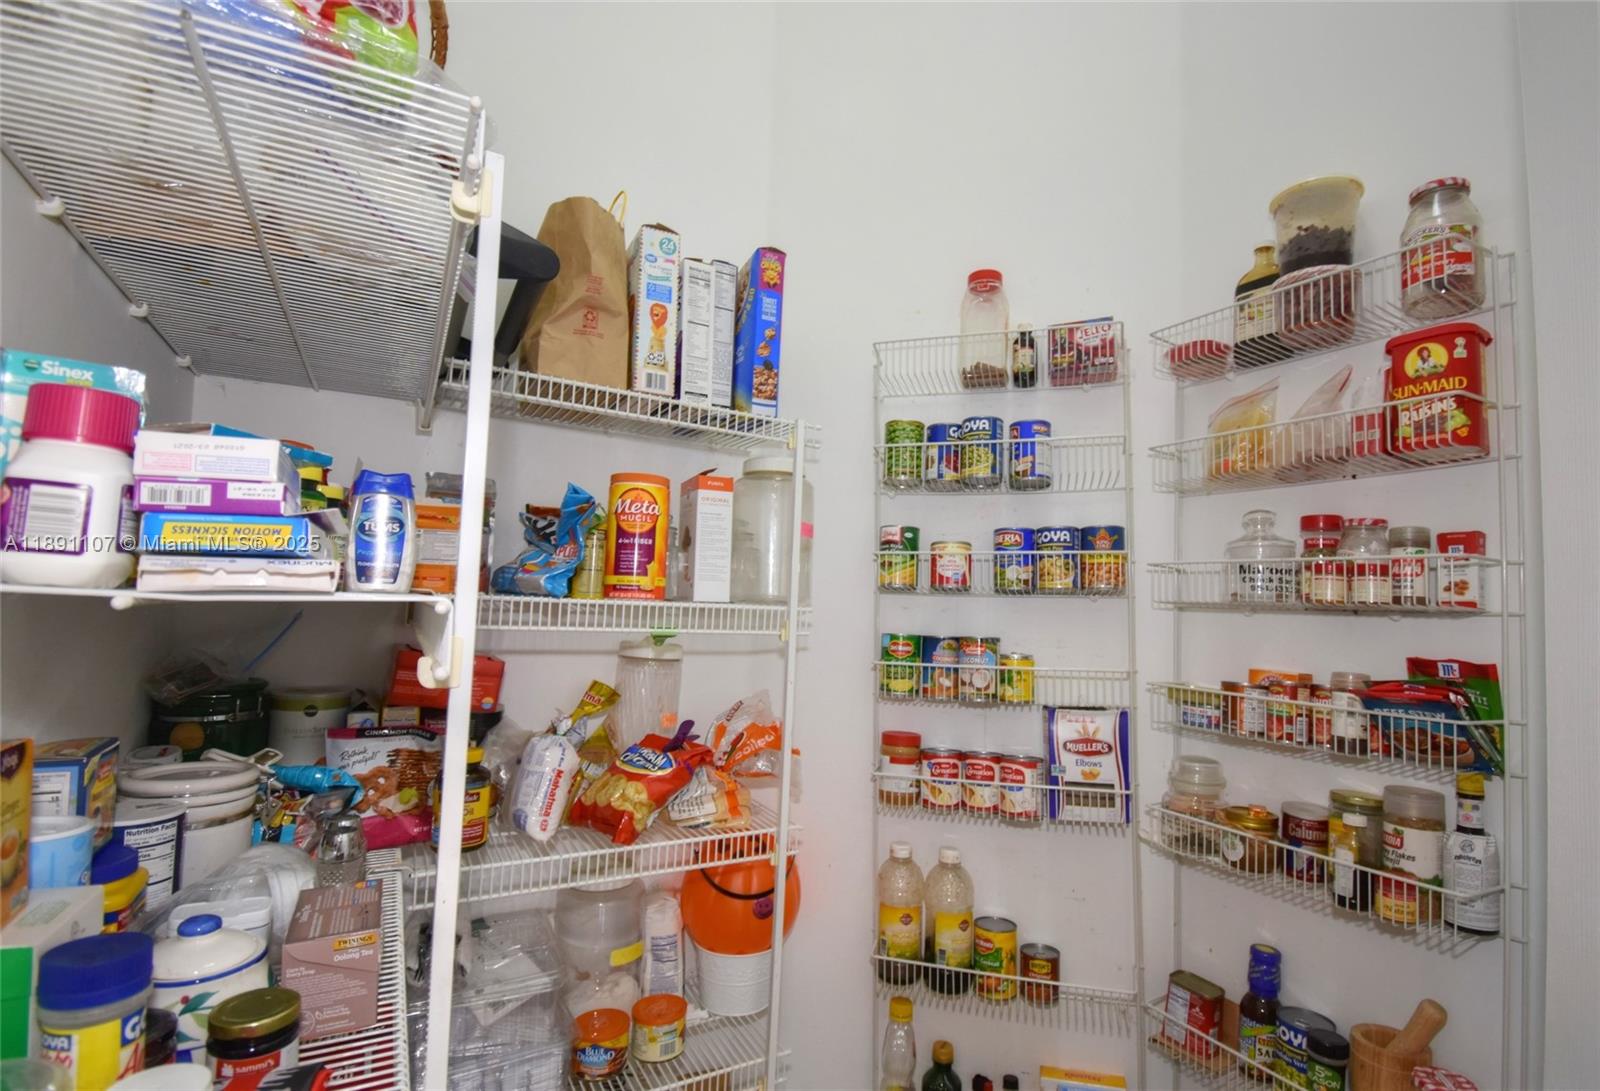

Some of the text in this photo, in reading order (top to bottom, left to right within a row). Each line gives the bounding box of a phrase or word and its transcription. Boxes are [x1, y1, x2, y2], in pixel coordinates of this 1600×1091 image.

[40, 360, 94, 382] Sinex
[1392, 376, 1468, 400] SUN-MAID
[961, 418, 990, 433] OYA
[614, 498, 662, 516] Meta
[620, 514, 653, 523] MUCIL
[171, 525, 284, 537] MOTION SICKNESS
[1066, 741, 1109, 753] MUELLER'S
[1075, 759, 1103, 768] Elbows
[543, 768, 565, 818] Mahatma
[126, 826, 160, 838] Nutrition
[1288, 823, 1327, 841] Calum
[337, 935, 373, 947] TWININGS
[334, 951, 361, 963] Oolong
[41, 1035, 70, 1049] OYA
